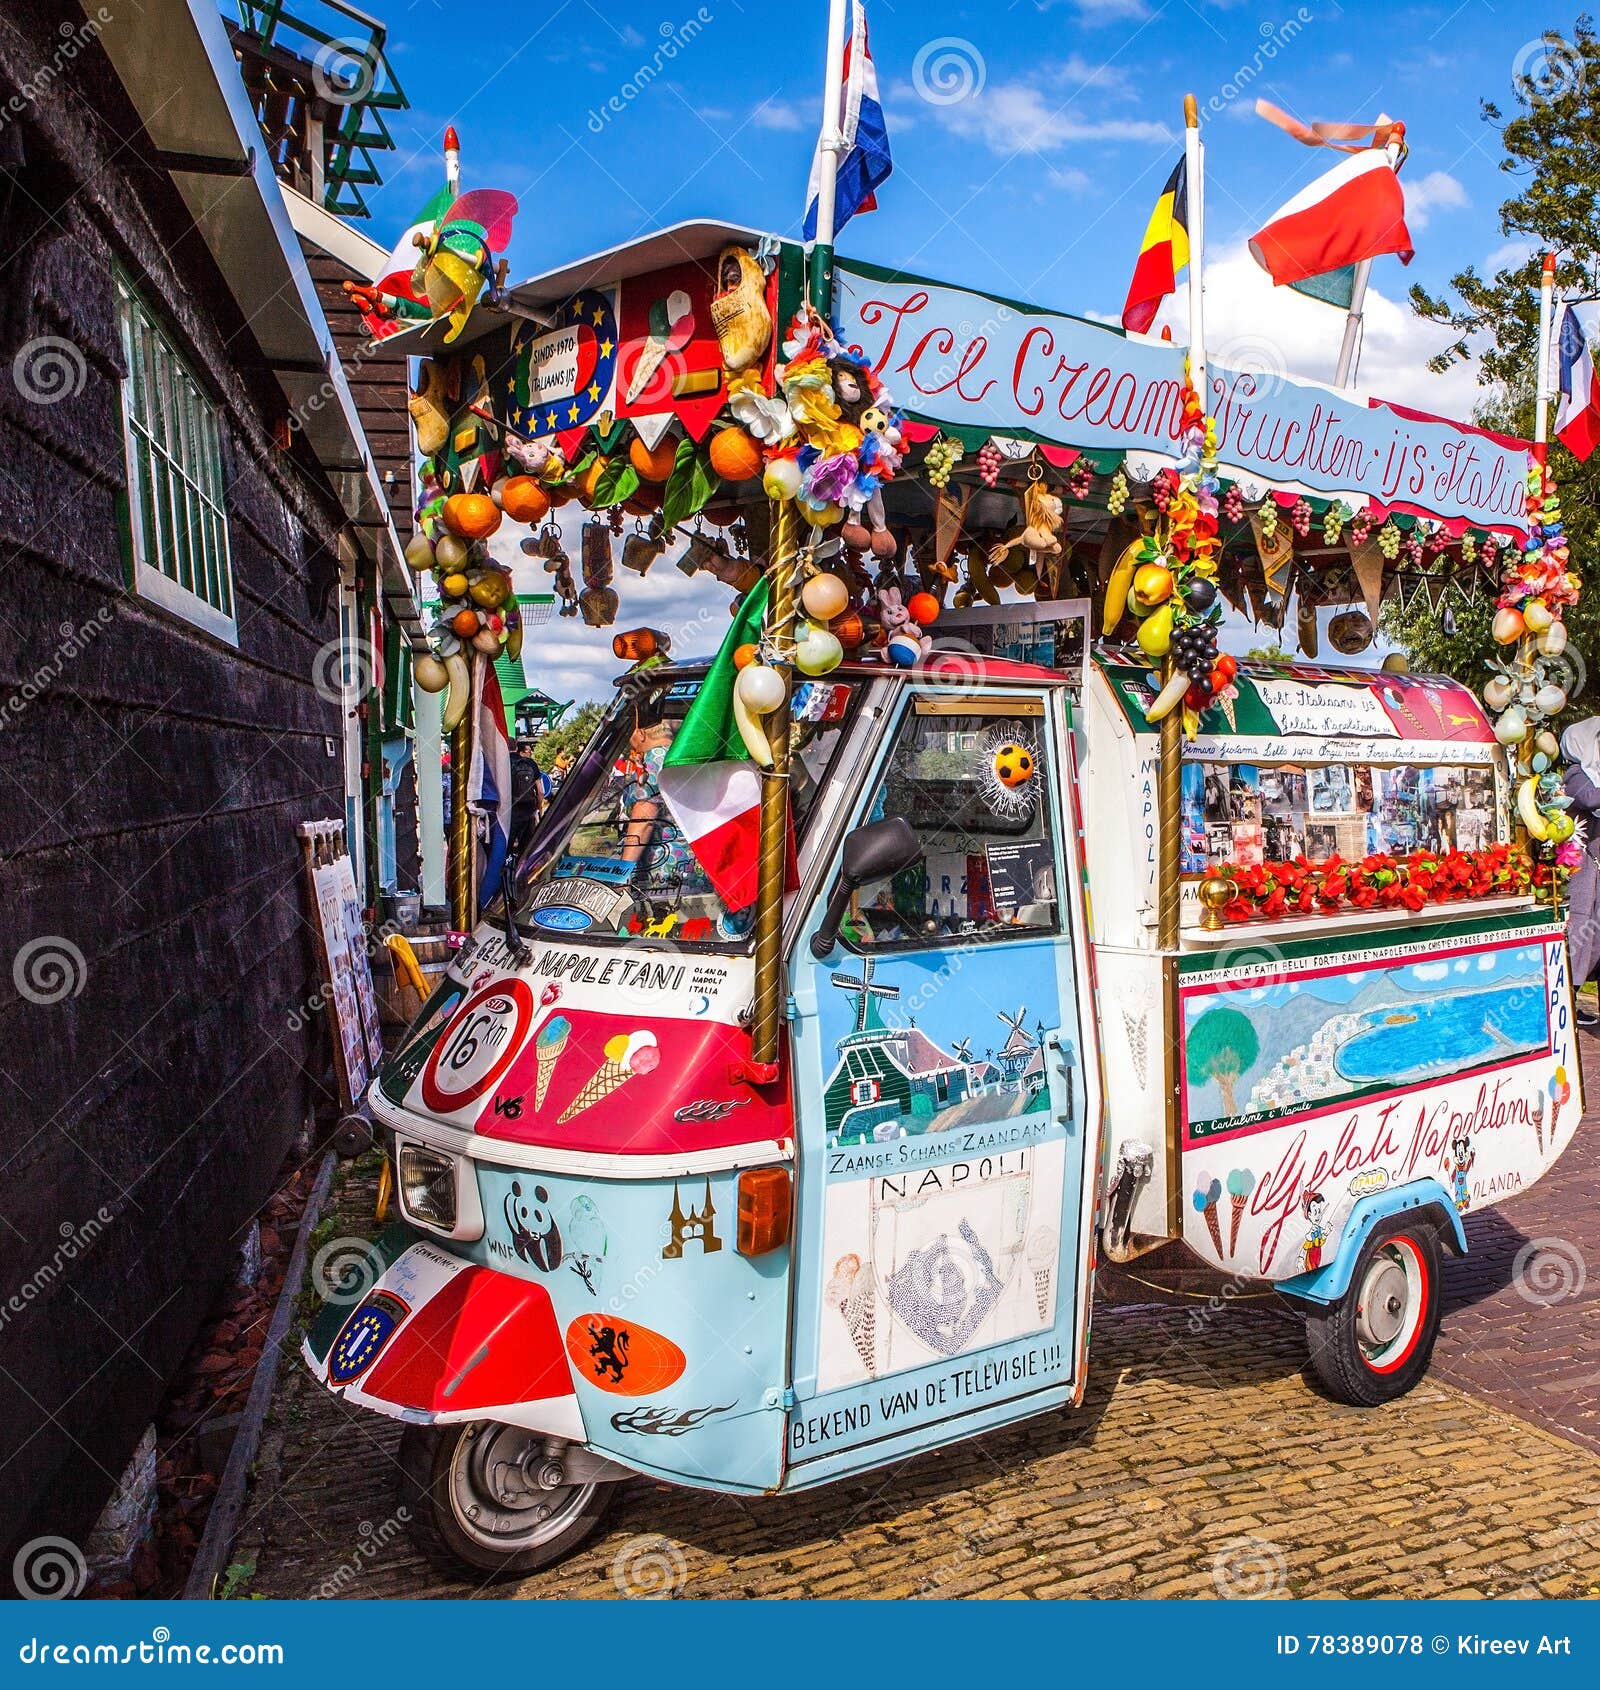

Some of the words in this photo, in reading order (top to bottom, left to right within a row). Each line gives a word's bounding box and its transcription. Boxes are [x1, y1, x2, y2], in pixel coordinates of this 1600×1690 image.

[531, 370, 565, 393] ITALIAANS
[847, 292, 998, 403] Ice
[1013, 326, 1184, 441] Cream
[1213, 373, 1372, 483] Vruchten
[1381, 428, 1427, 497] ijs
[1433, 439, 1530, 518] Italia
[1140, 759, 1155, 884] NAPOLI
[532, 949, 686, 991] NAPOLETANI
[694, 967, 728, 978] OLANDA
[1254, 963, 1278, 976] FATTI
[1282, 960, 1308, 973] BELLI
[1313, 956, 1338, 968] FORTI
[1342, 952, 1362, 965] SANI
[1460, 934, 1481, 947] PAESE
[688, 985, 719, 996] ITALIA
[691, 976, 722, 986] NAPOLI
[1548, 942, 1568, 1067] NAPOLI
[439, 1012, 491, 1071] 16
[481, 1017, 508, 1047] km
[829, 1152, 893, 1175] ZAANSE
[899, 1140, 956, 1164] SCHANS
[963, 1122, 1047, 1151] ZAANDAM
[881, 1151, 1025, 1201] NAPOLI
[1250, 1099, 1403, 1276] Gelati
[1353, 1174, 1385, 1191] ITALIA
[487, 1238, 514, 1260] WNF
[793, 1404, 871, 1450] BEKEND
[880, 1388, 919, 1421] VAN
[925, 1378, 947, 1407] DE
[950, 1350, 1038, 1399] TELEVISIE
